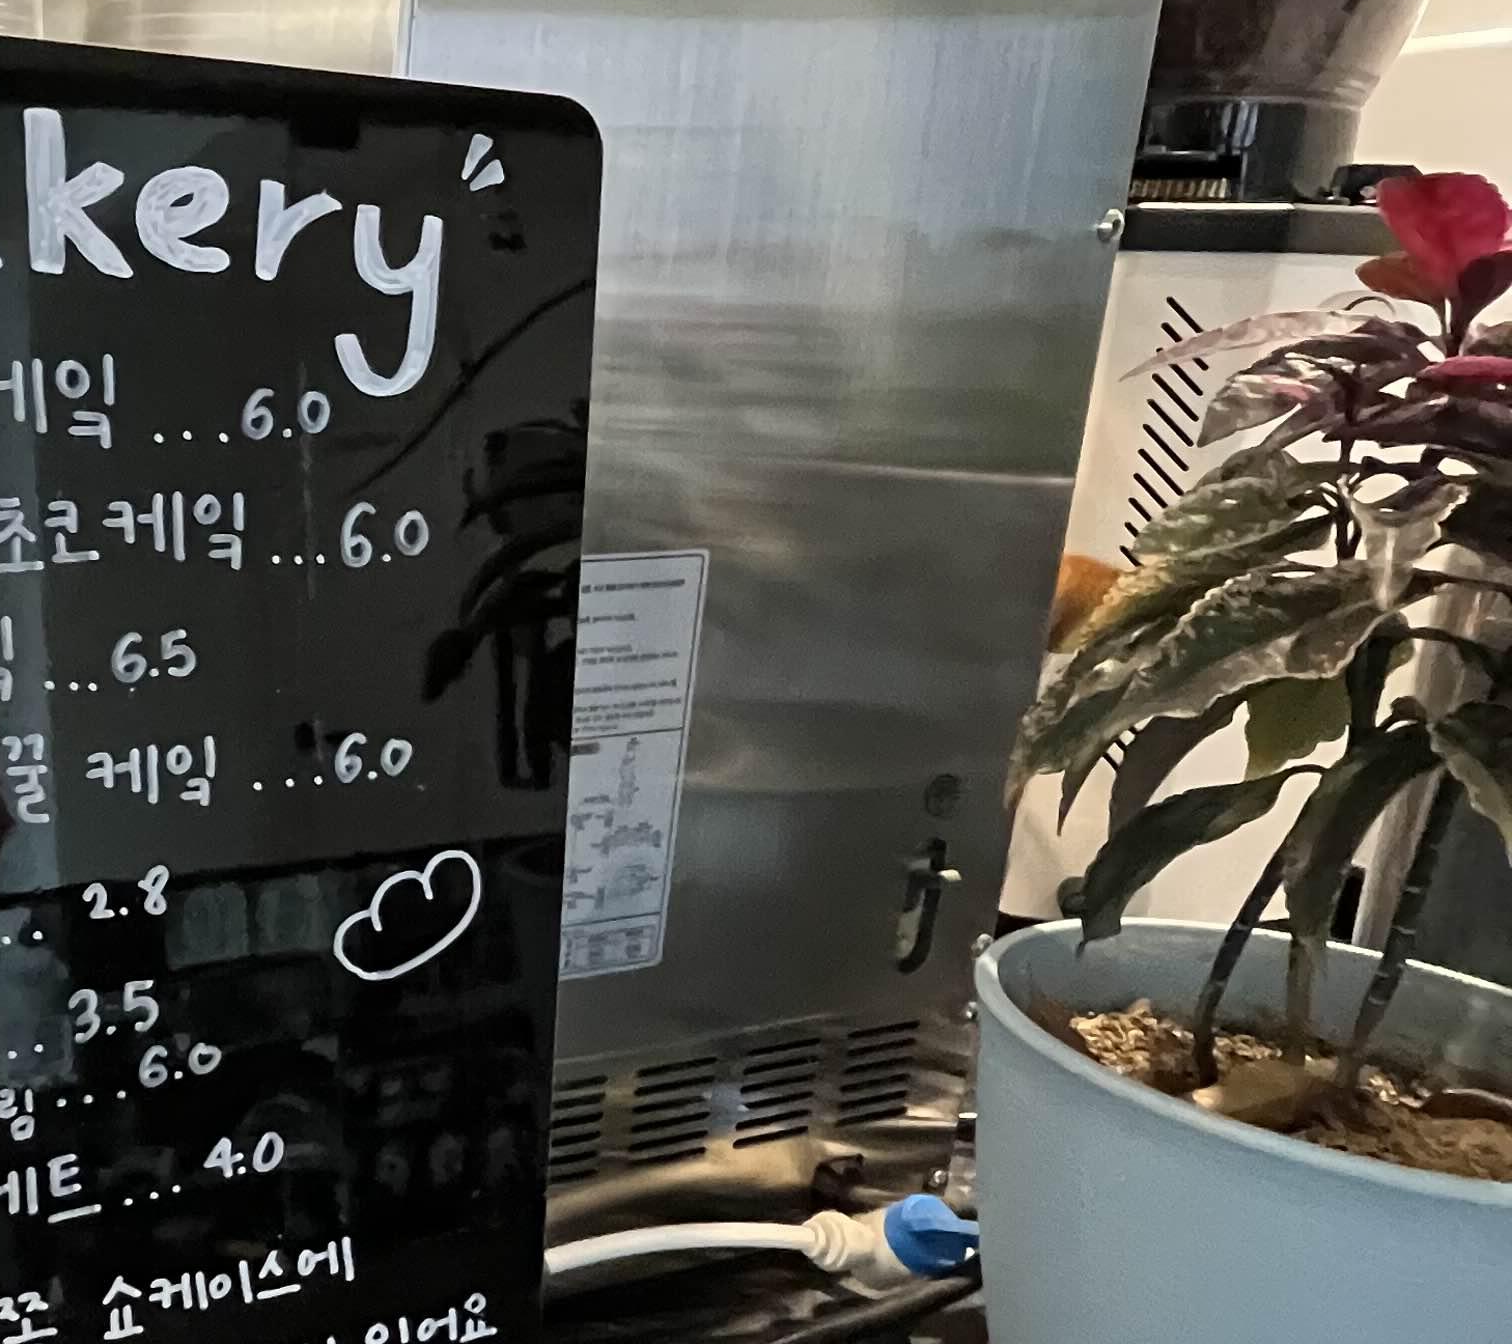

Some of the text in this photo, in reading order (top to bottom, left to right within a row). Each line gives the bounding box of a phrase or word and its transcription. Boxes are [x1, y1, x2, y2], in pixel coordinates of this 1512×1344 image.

[1, 733, 50, 824] 꿀
[85, 735, 216, 806] 케잌
[82, 864, 170, 919] 2.8
[68, 980, 159, 1043] 3.5
[139, 1043, 222, 1088] 6.0
[203, 1131, 286, 1177] 4.0
[102, 1236, 355, 1342] 쇼케이스에
